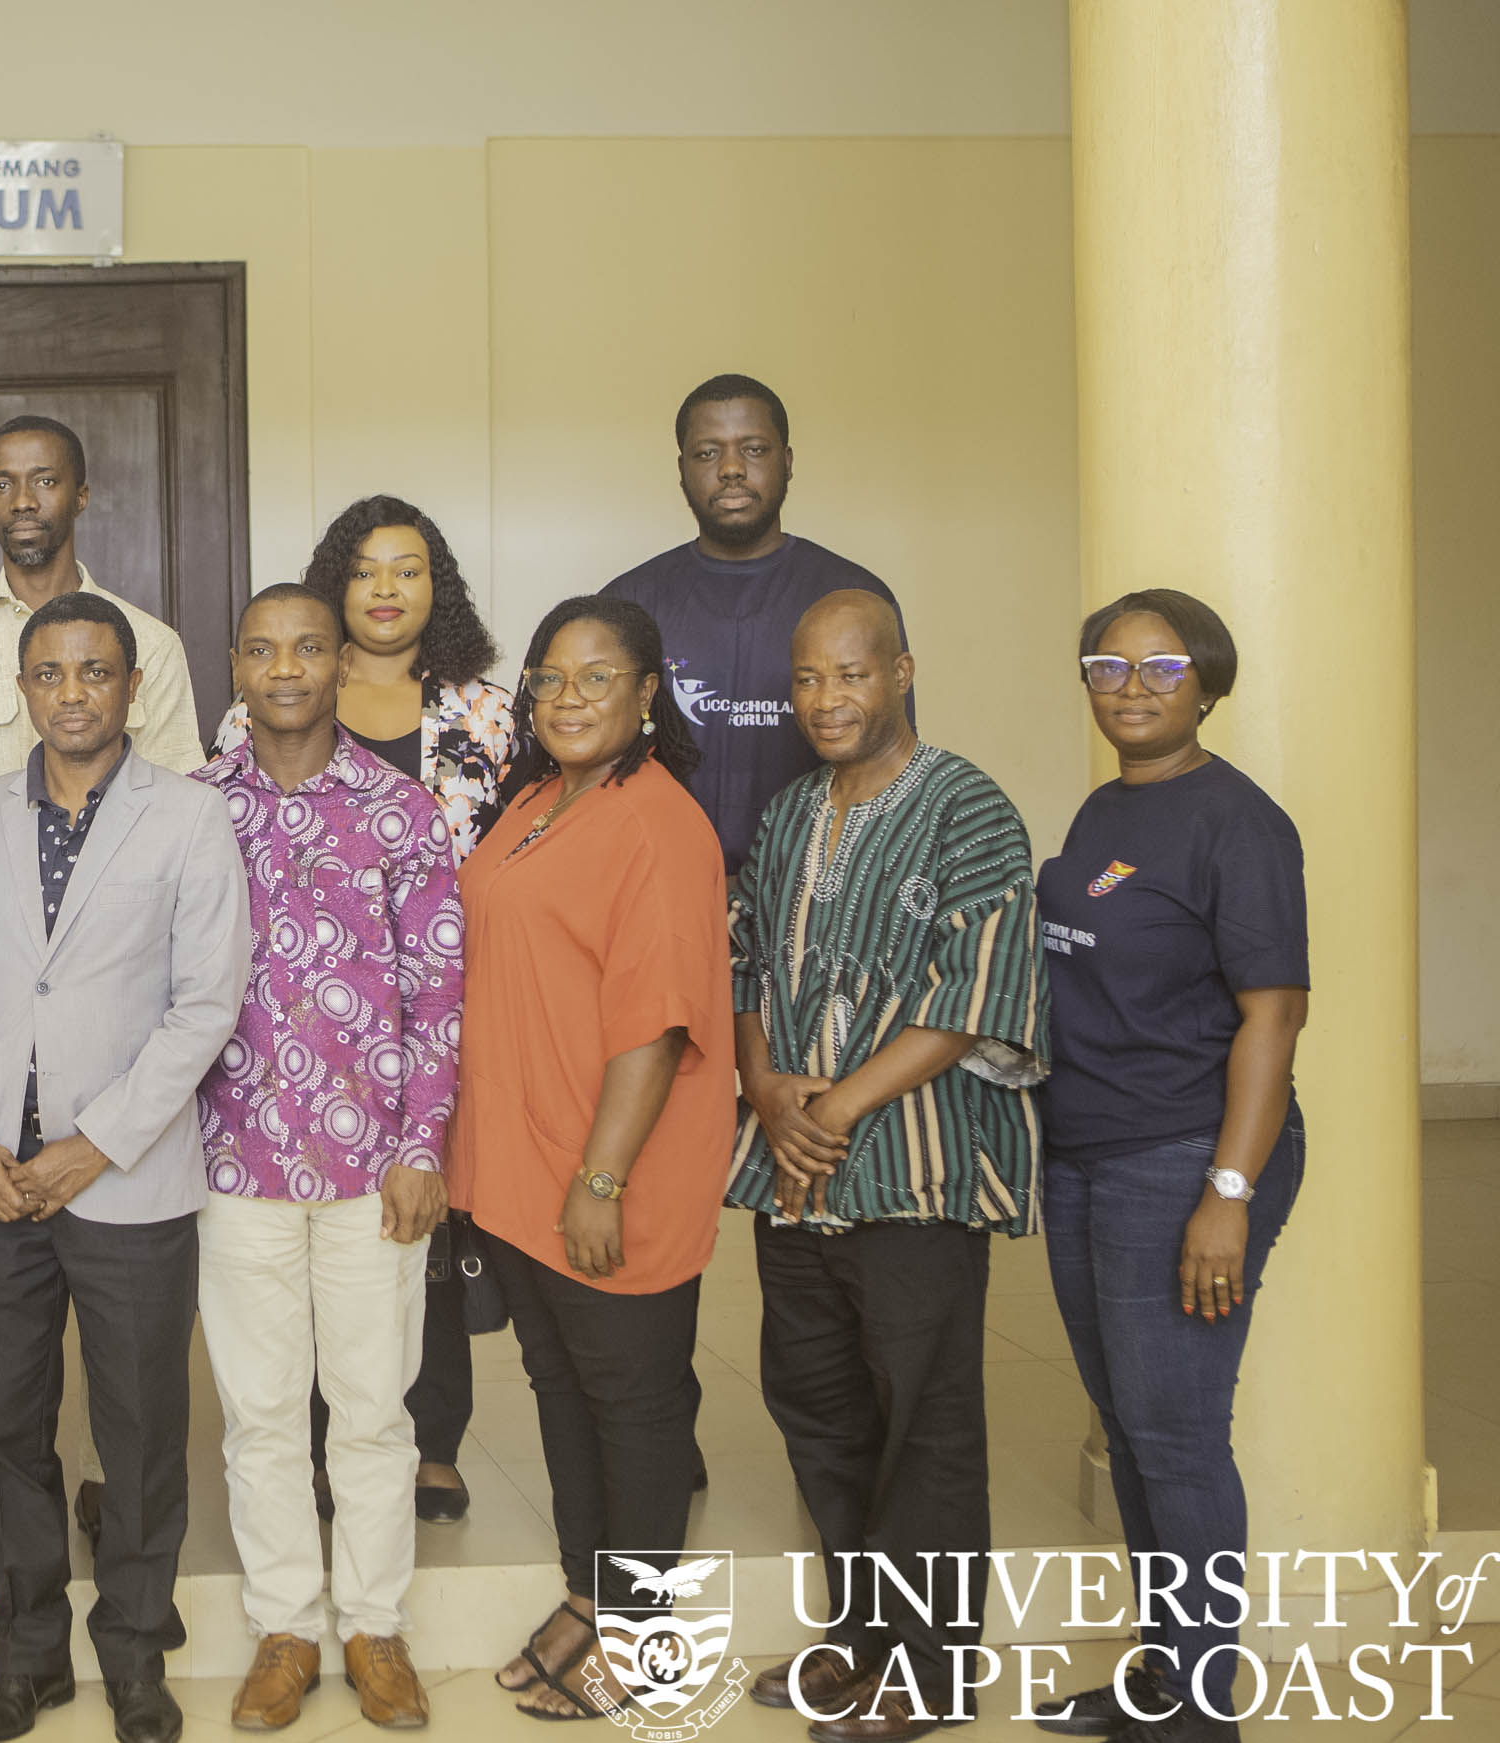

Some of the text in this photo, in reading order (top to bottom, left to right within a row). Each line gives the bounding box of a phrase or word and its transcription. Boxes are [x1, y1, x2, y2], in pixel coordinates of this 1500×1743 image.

[700, 698, 794, 714] UCC SCHOLA
[728, 713, 780, 727] FORUM
[1043, 921, 1097, 948] CHOLARS
